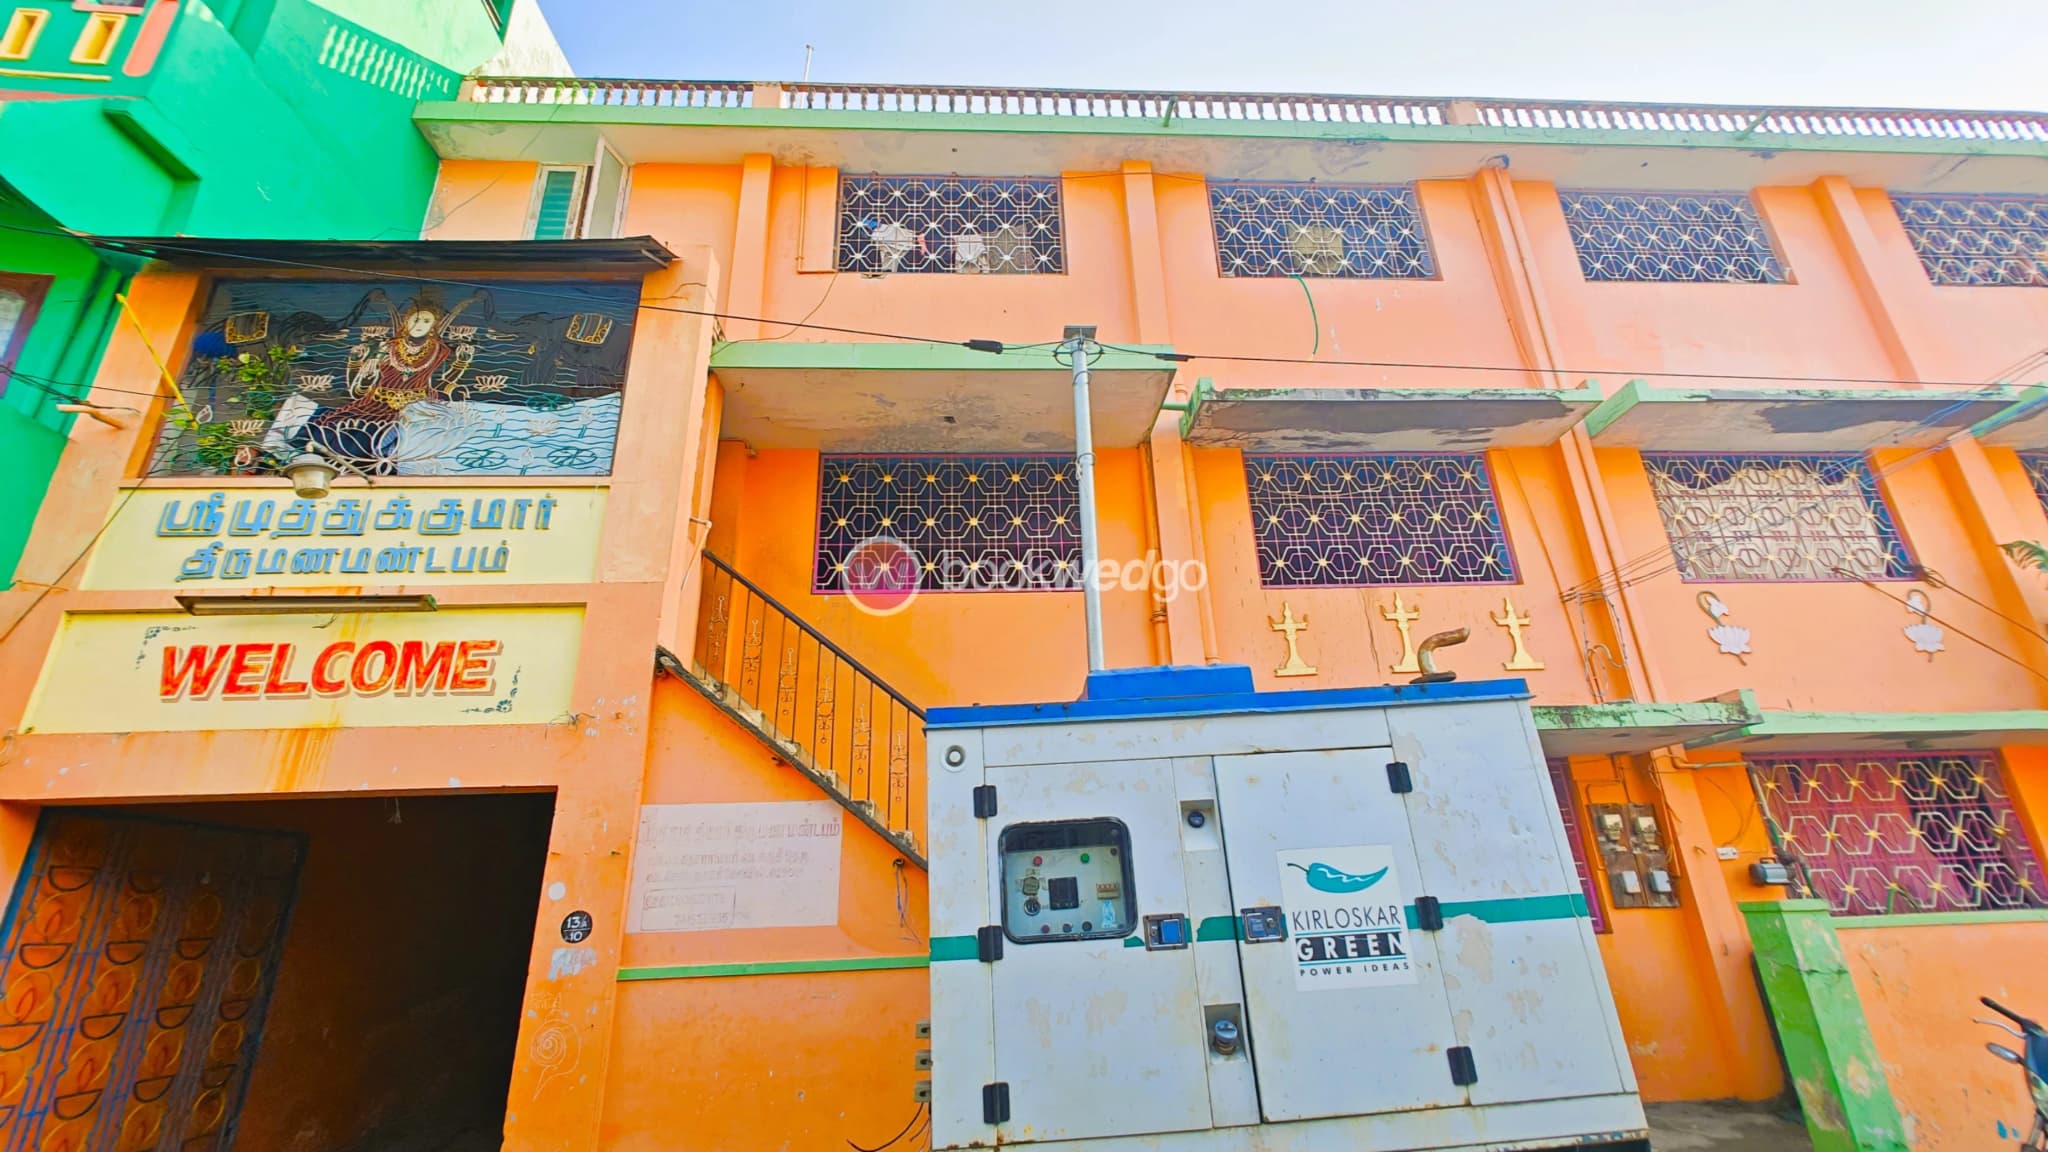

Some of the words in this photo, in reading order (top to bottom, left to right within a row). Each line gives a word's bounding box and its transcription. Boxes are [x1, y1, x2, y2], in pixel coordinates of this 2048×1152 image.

[175, 540, 510, 582] திருமணமண்டபம்
[160, 640, 501, 701] WELCOME
[1292, 904, 1401, 931] KIRLOSKAR
[1296, 933, 1406, 962] GREEN
[1300, 966, 1353, 977] POWER
[1364, 962, 1410, 974] IDEAS
